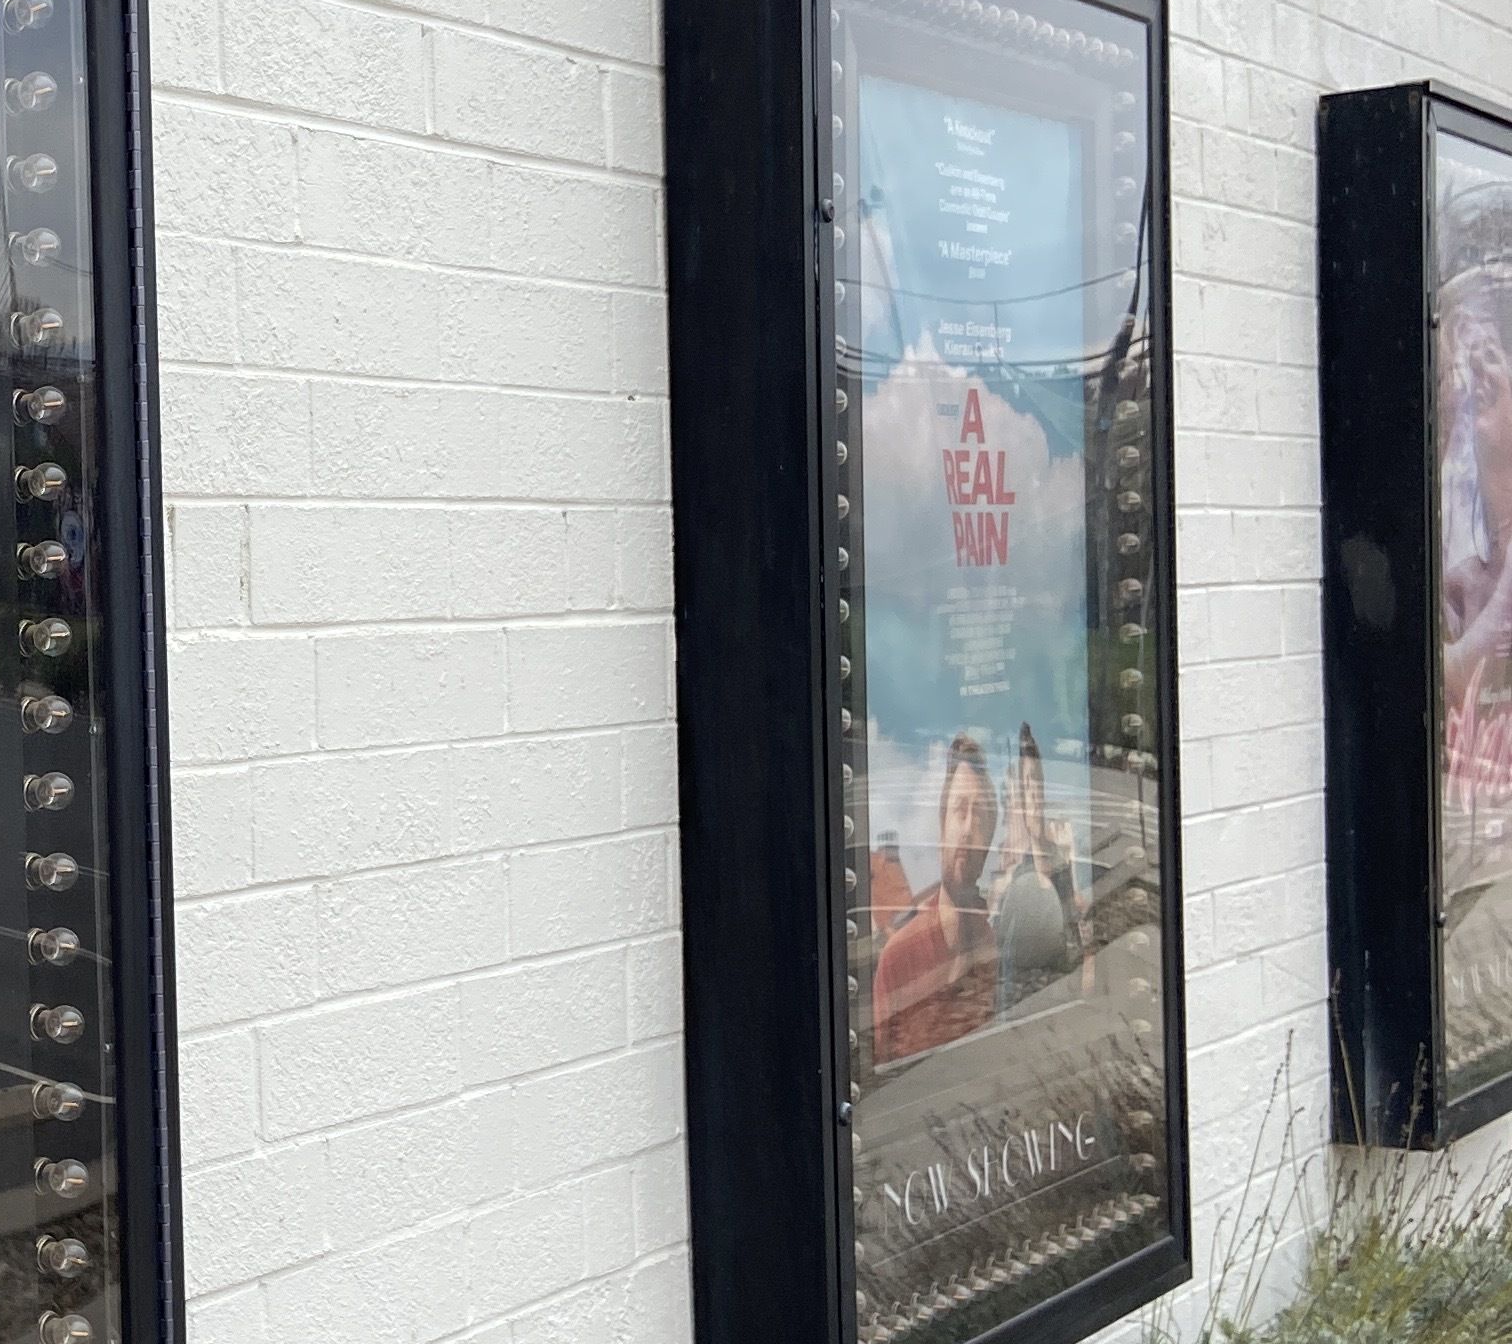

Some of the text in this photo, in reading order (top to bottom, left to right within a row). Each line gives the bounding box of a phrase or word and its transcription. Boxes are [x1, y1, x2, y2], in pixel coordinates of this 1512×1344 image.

[960, 389, 985, 443] A
[942, 449, 1015, 504] REAL
[952, 512, 1009, 567] PAIN
